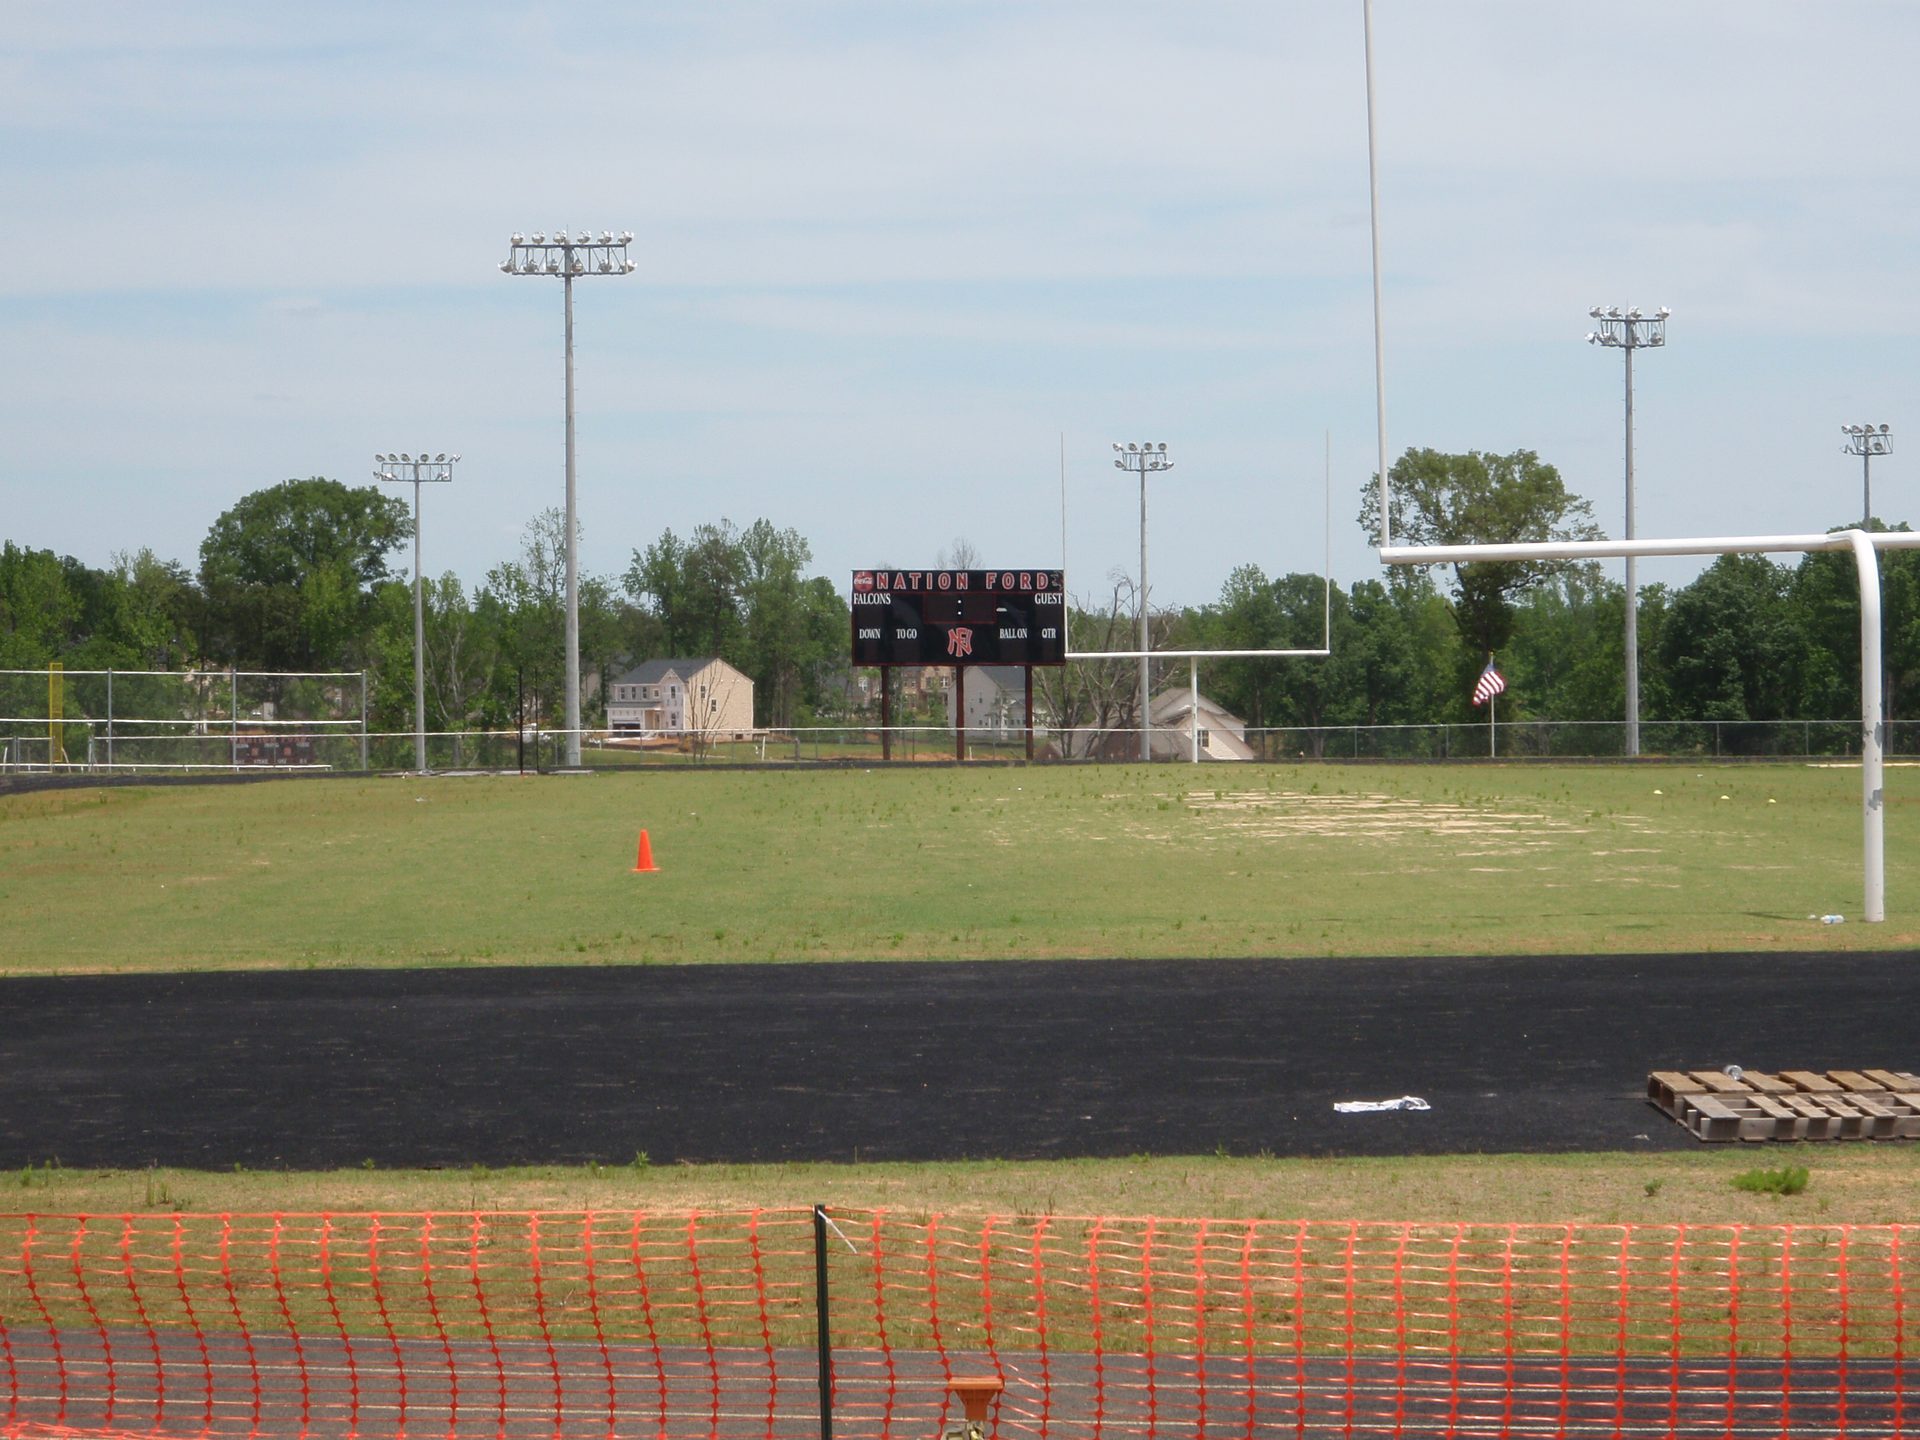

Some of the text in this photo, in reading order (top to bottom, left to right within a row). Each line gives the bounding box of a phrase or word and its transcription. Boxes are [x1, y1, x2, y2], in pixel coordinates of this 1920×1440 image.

[876, 572, 1049, 590] NATION FORD
[853, 592, 891, 605] FALCONS
[1034, 592, 1063, 605] GUEST
[859, 628, 881, 639] DOWN
[896, 628, 918, 639] TO GO
[999, 628, 1028, 639] BALL ON
[1041, 627, 1057, 639] QTR
